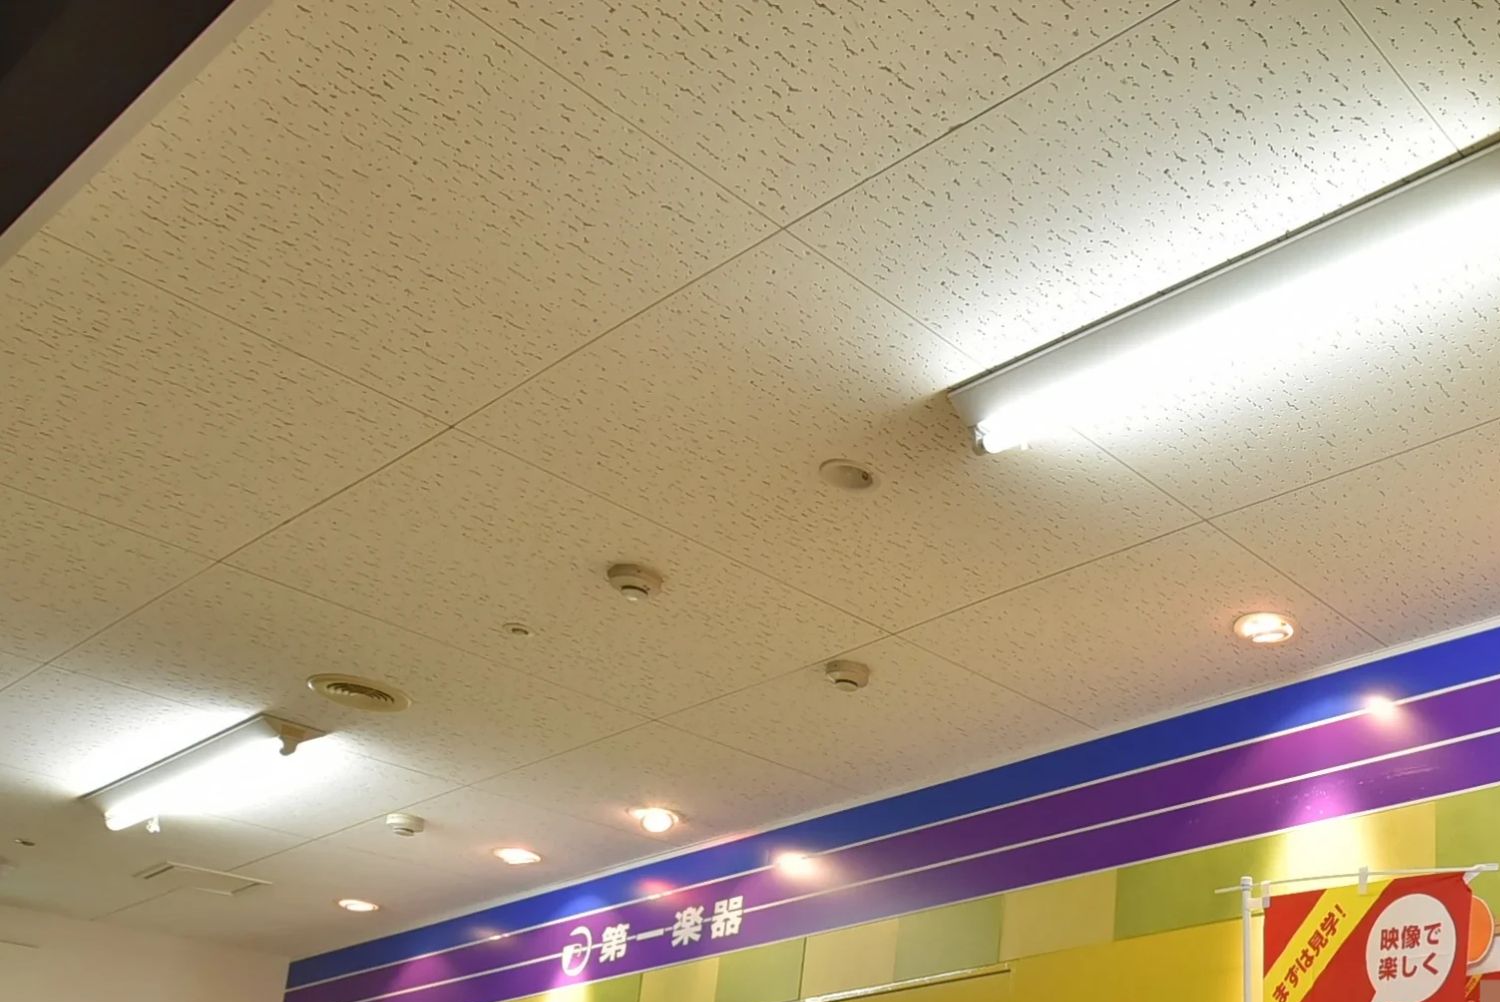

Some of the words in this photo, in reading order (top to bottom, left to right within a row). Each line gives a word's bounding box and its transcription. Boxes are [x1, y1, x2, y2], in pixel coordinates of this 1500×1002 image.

[599, 896, 744, 963] 第一楽器
[1379, 921, 1441, 950] 映像で
[1378, 957, 1438, 982] 楽しく
